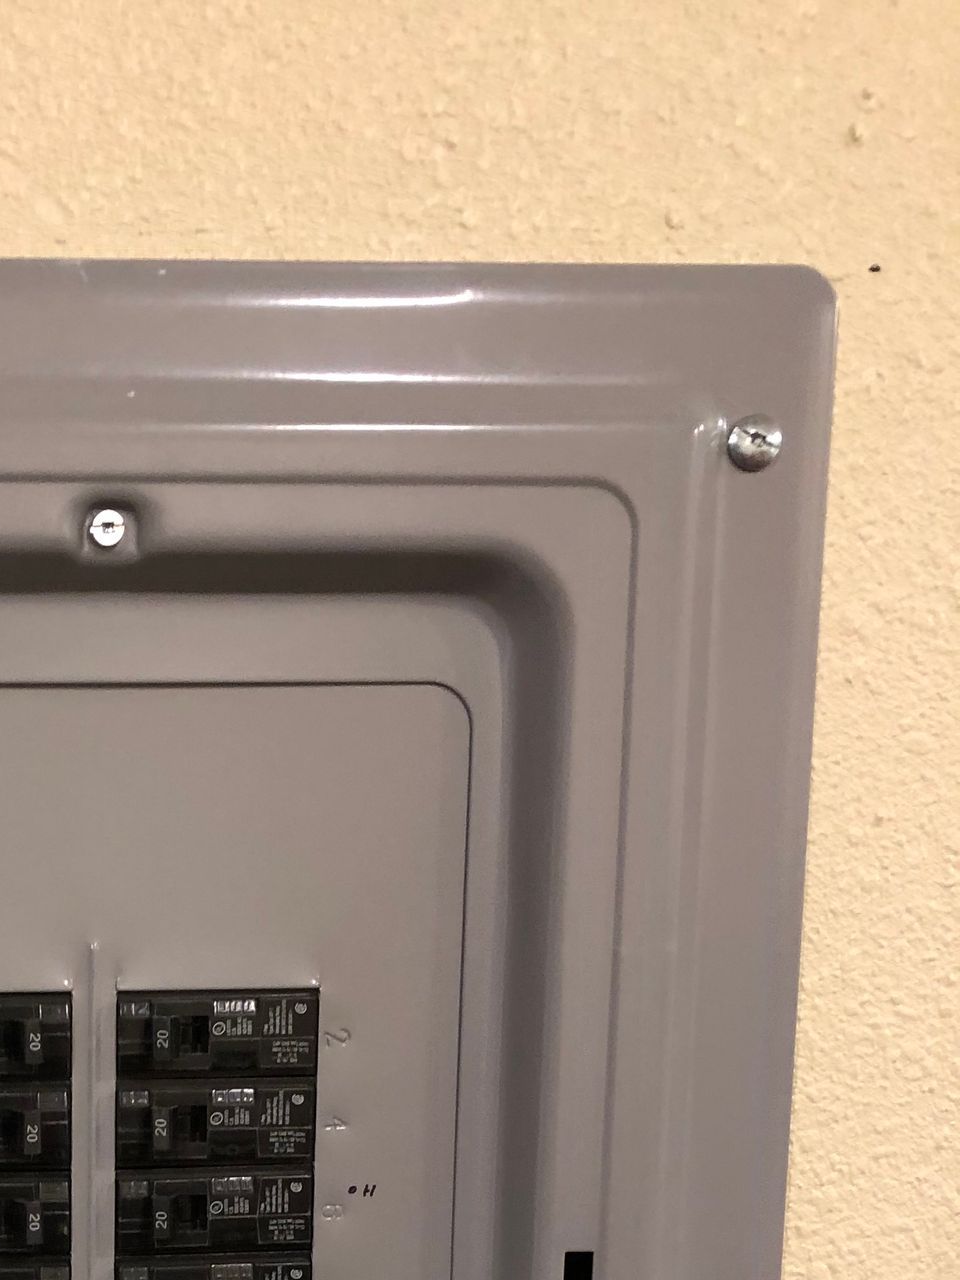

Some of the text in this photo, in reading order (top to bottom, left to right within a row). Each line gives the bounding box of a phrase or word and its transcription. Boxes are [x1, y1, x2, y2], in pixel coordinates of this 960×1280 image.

[30, 1032, 41, 1051] 20
[157, 1029, 169, 1049] 20
[27, 1124, 39, 1143] 20
[155, 1118, 167, 1137] 20
[29, 1213, 40, 1232] 20
[156, 1211, 168, 1230] 20
